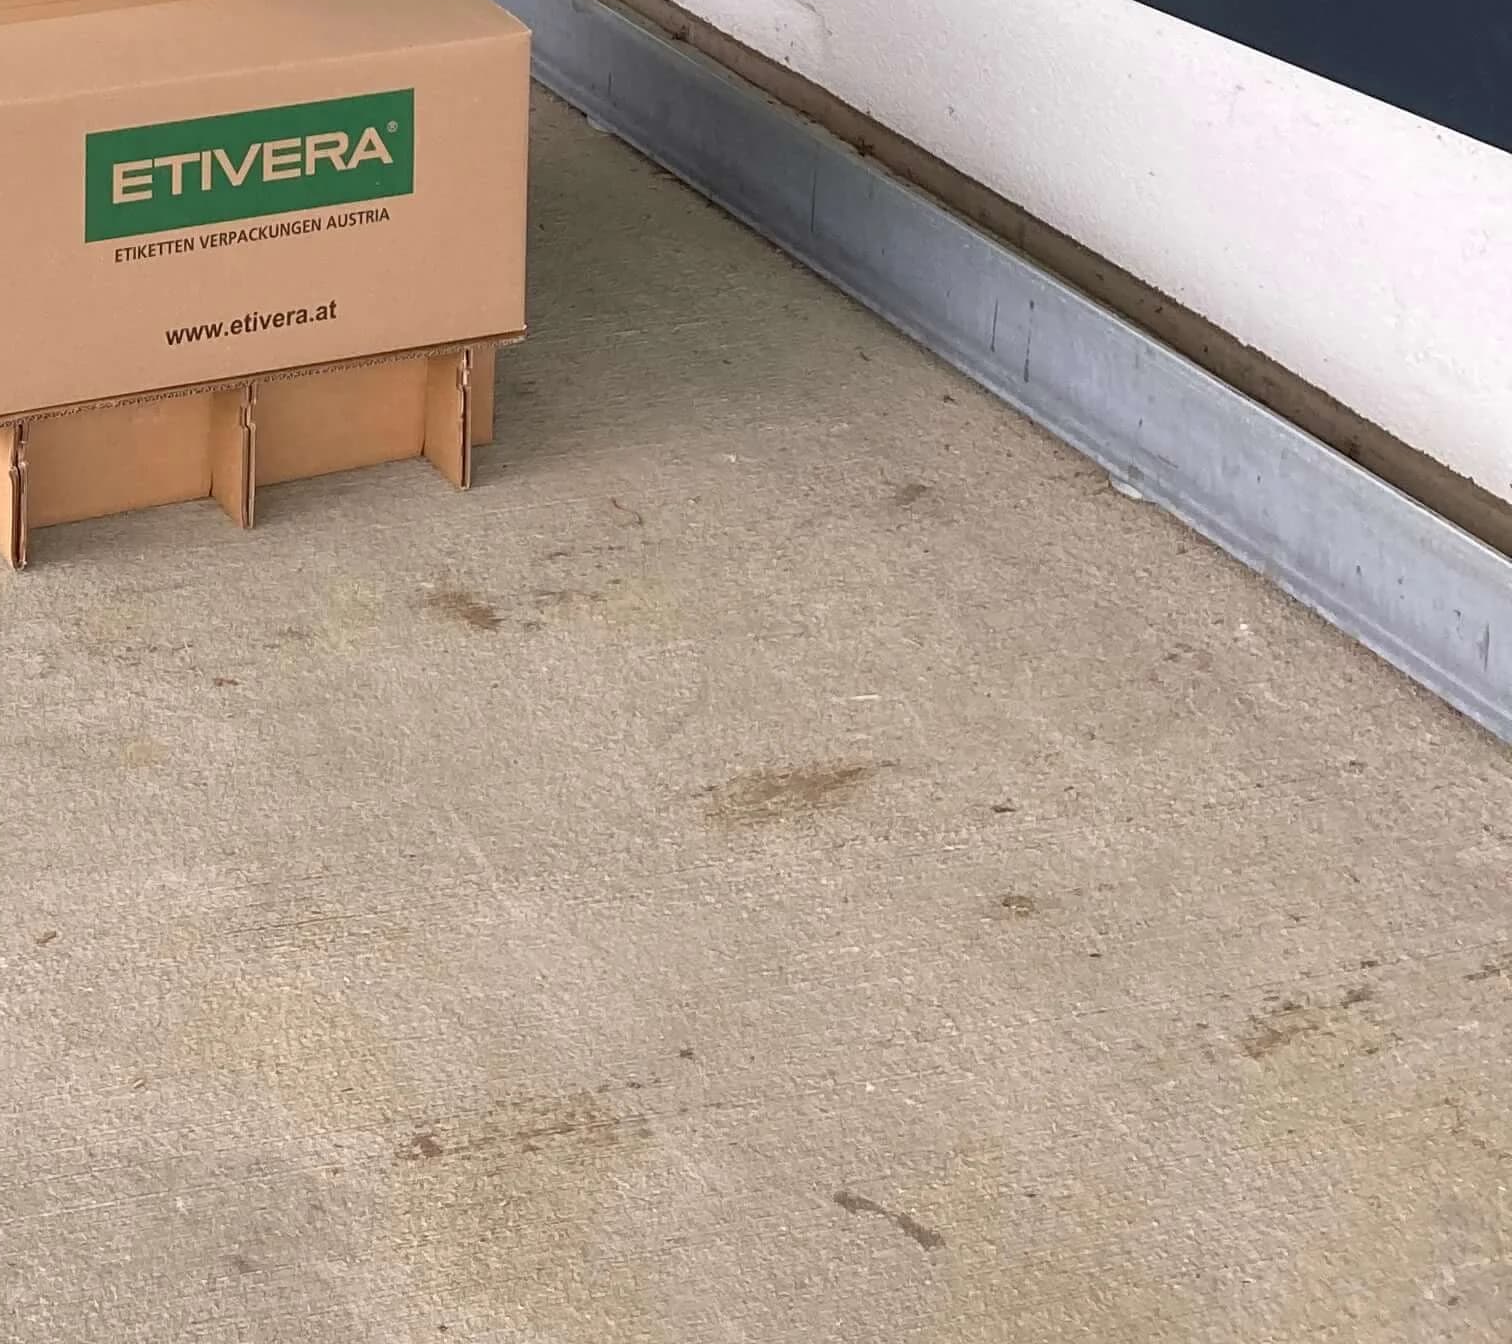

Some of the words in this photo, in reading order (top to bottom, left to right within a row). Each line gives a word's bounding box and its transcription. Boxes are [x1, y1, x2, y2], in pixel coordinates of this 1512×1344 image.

[114, 237, 195, 264] ETIKETTEN
[199, 217, 322, 250] VERPACKUNGEN
[326, 206, 391, 231] AUSTRIA
[165, 299, 338, 346] www.etivera.at
